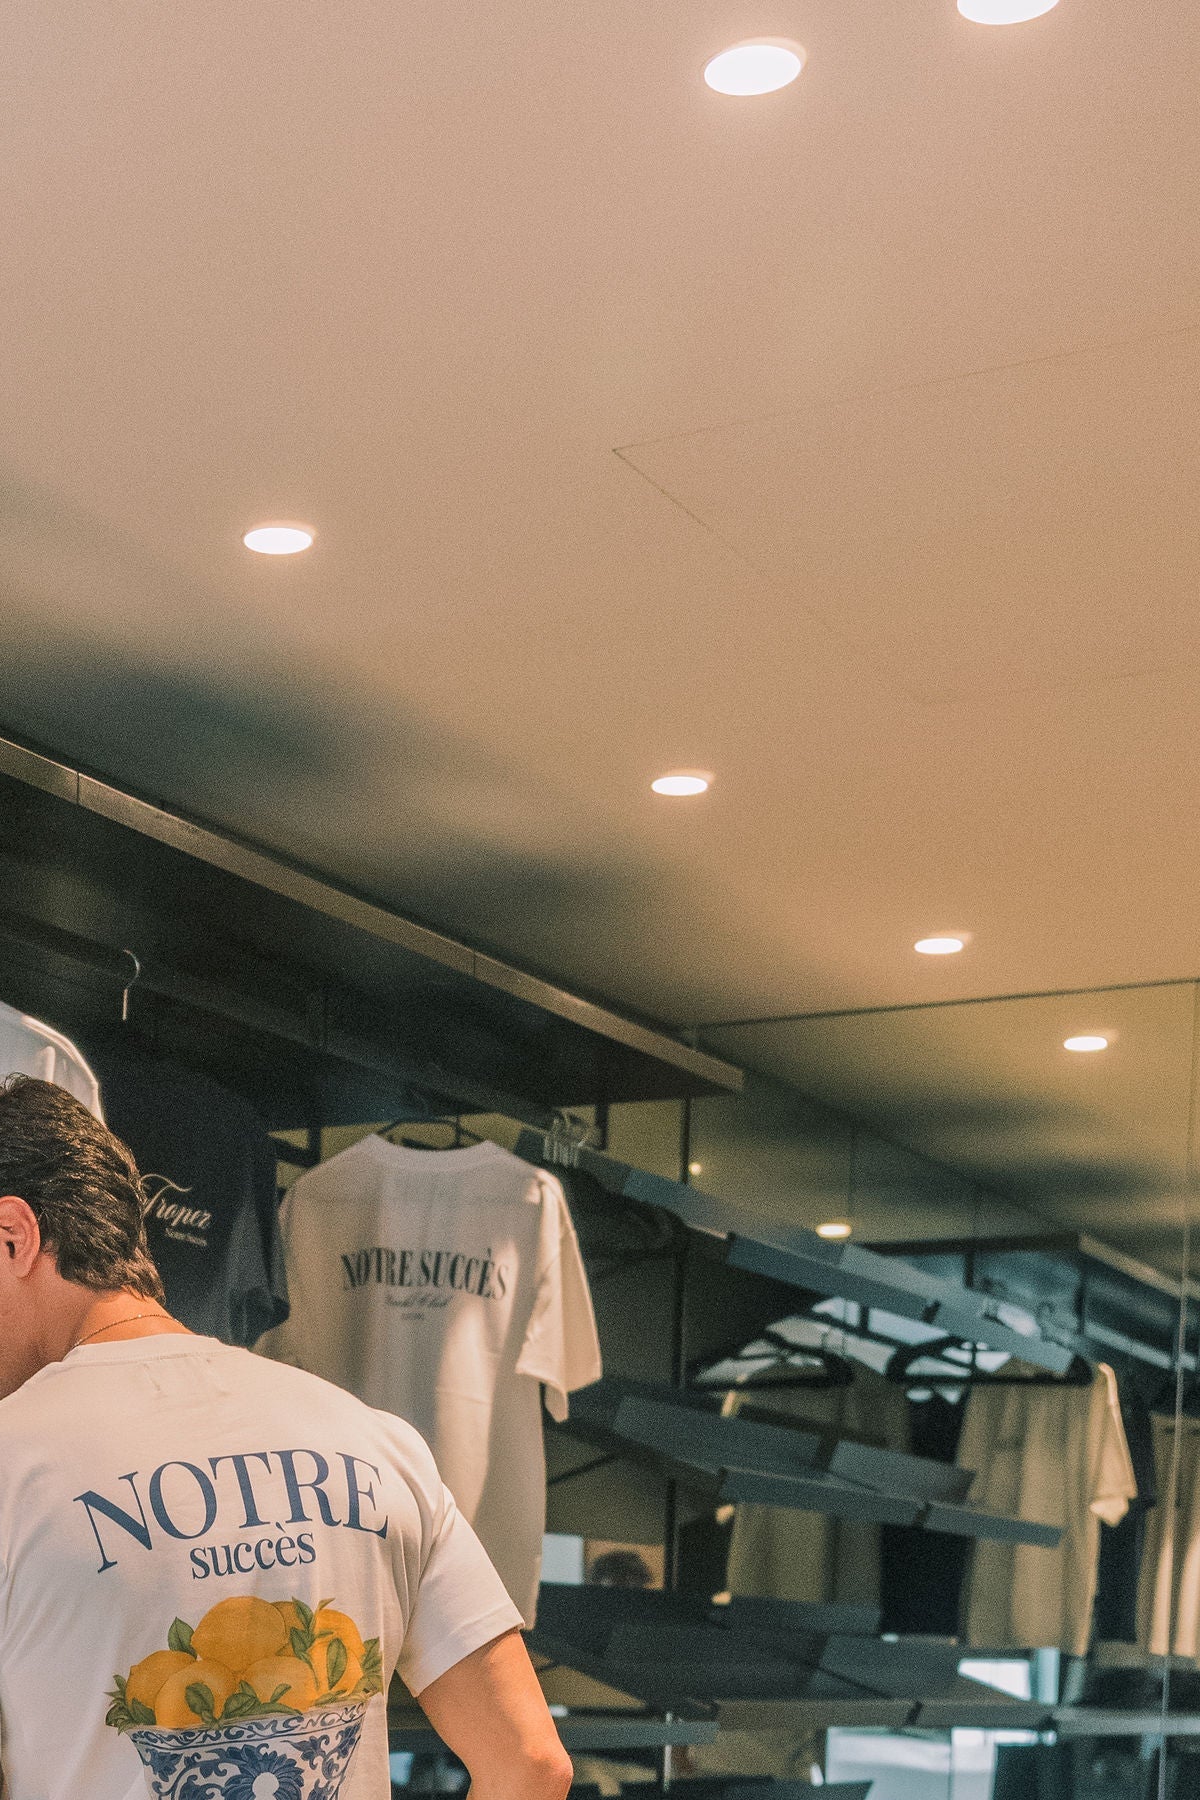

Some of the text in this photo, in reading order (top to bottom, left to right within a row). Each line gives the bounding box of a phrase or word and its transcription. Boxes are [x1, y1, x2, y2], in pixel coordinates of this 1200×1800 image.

[341, 1247, 508, 1300] NOTRE SUCCÈS
[72, 1448, 389, 1574] NOTRE
[189, 1521, 316, 1580] succès
